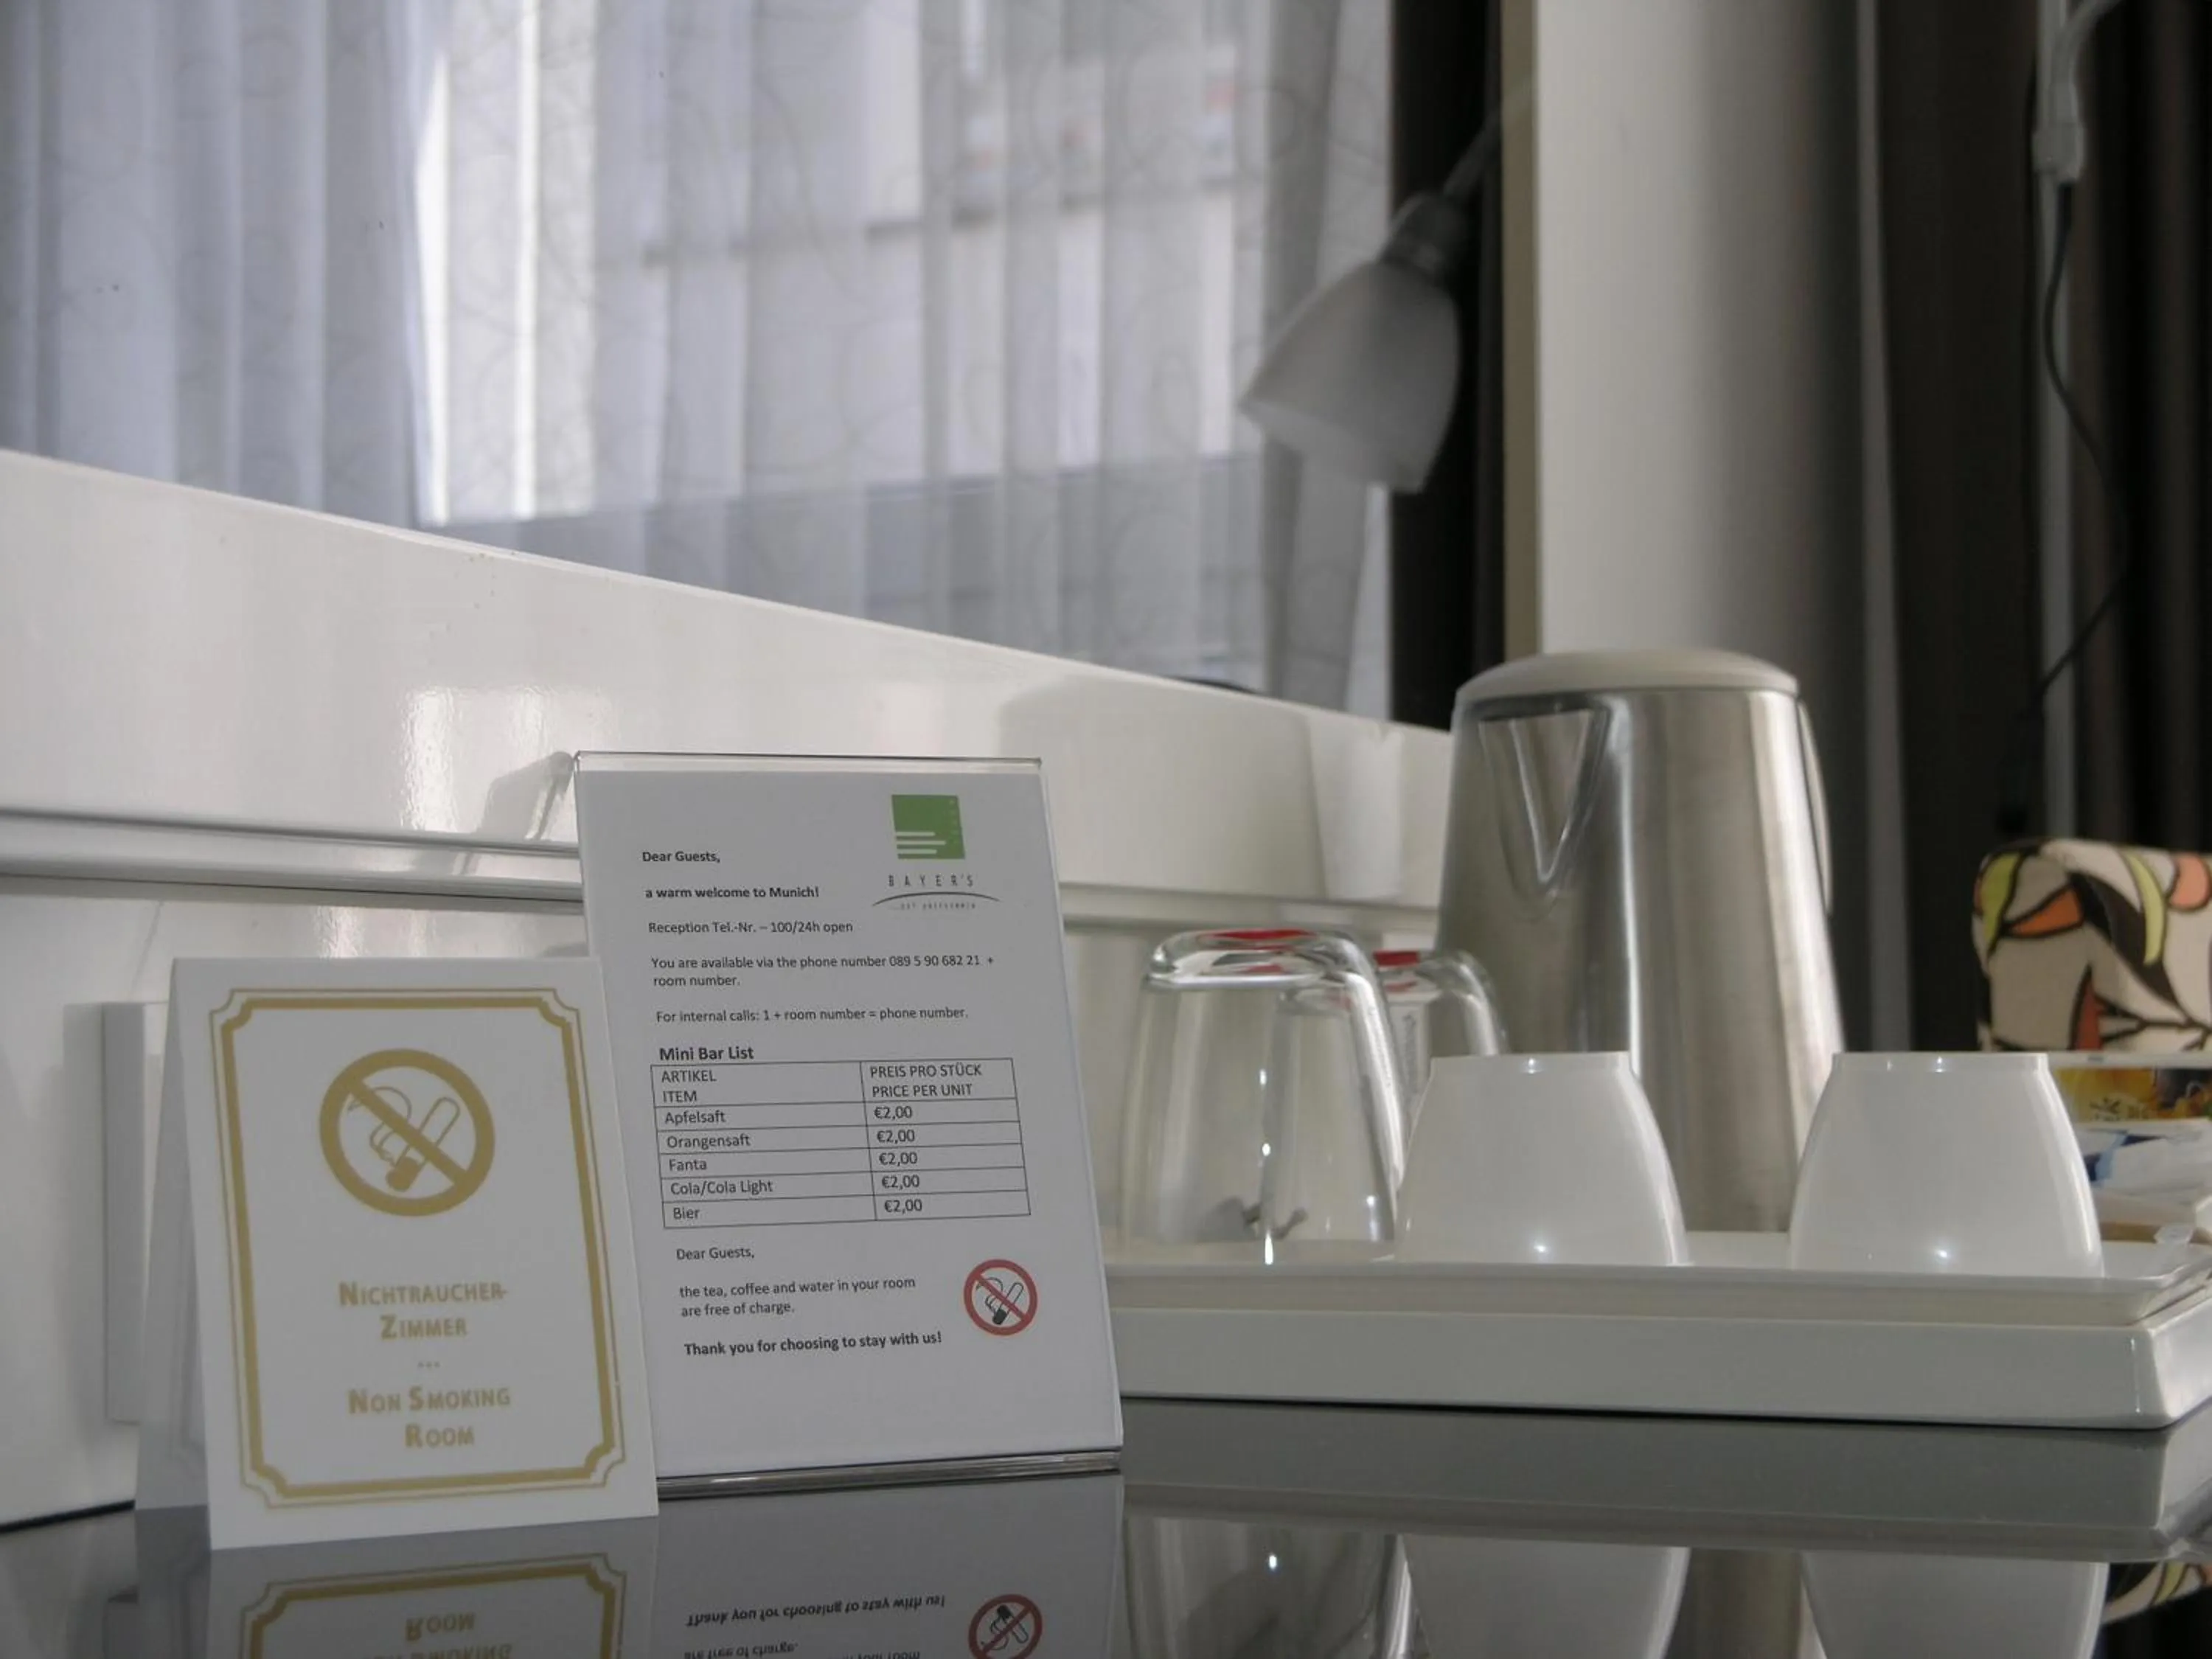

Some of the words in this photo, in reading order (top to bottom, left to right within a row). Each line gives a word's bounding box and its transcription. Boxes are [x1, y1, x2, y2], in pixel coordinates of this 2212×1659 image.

[641, 851, 672, 862] Dear
[675, 850, 720, 863] Guests,
[645, 889, 653, 899] a
[655, 888, 692, 898] warm
[694, 886, 751, 898] welcome
[752, 888, 767, 898] to
[769, 886, 819, 898] Munich!
[648, 922, 710, 936] Reception
[712, 921, 757, 933] Tel.-Nr.
[771, 919, 821, 935] 100/24h
[823, 922, 853, 935] open
[650, 957, 675, 969] You
[678, 959, 698, 969] are
[700, 956, 754, 969] available
[756, 956, 774, 968] via
[776, 956, 797, 968] the
[799, 955, 838, 970] phone
[840, 955, 887, 967] number
[888, 955, 911, 967] 089
[913, 955, 922, 967] 5
[923, 955, 939, 967] 90
[941, 955, 964, 967] 682
[966, 955, 980, 966] 21
[653, 977, 686, 987] room
[689, 974, 740, 987] number.
[656, 1011, 677, 1023] For
[679, 1009, 727, 1023] internal
[728, 1009, 760, 1022] calls:
[763, 1009, 770, 1021] 1
[784, 1011, 817, 1021] room
[819, 1007, 866, 1020] number
[879, 1007, 918, 1021] phone
[919, 1006, 968, 1019] number.
[659, 1046, 695, 1061] Mini
[698, 1046, 725, 1061] Bar
[728, 1046, 754, 1060] List
[661, 1069, 717, 1083] ARTIKEL
[869, 1065, 907, 1079] PREIS
[909, 1064, 937, 1078] PRO
[938, 1062, 983, 1078] STÜCK
[662, 1090, 698, 1104] ITEM
[872, 1085, 910, 1098] PRICE
[912, 1085, 939, 1097] PER
[940, 1082, 973, 1097] UNIT
[664, 1109, 726, 1127] Apfelsaft
[874, 1105, 913, 1121] €2,00
[666, 1132, 752, 1152] Orangensaft
[876, 1129, 916, 1145] €2,00
[669, 1158, 708, 1172] Fanta
[878, 1151, 918, 1167] €2,00
[670, 1180, 737, 1197] Cola/Cola
[740, 1179, 773, 1196] Light
[881, 1174, 920, 1191] €2,00
[672, 1206, 700, 1220] Bier
[883, 1198, 923, 1214] €2,00
[676, 1248, 706, 1261] Dear
[709, 1247, 755, 1260] Guests,
[679, 1285, 700, 1298] the
[703, 1285, 728, 1298] tea,
[730, 1282, 771, 1296] coffee
[773, 1281, 796, 1295] and
[798, 1281, 835, 1293] water
[837, 1279, 849, 1292] in
[851, 1279, 880, 1293] your
[883, 1278, 916, 1290] room
[681, 1307, 702, 1318] are
[703, 1303, 731, 1317] free
[733, 1301, 747, 1315] of
[748, 1301, 795, 1316] charge.
[684, 1341, 726, 1356] Thank
[728, 1343, 754, 1357] you
[757, 1339, 777, 1353] for
[779, 1336, 840, 1352] choosing
[841, 1336, 857, 1349] to
[859, 1335, 887, 1349] stay
[889, 1332, 919, 1346] with
[922, 1330, 942, 1344] us!
